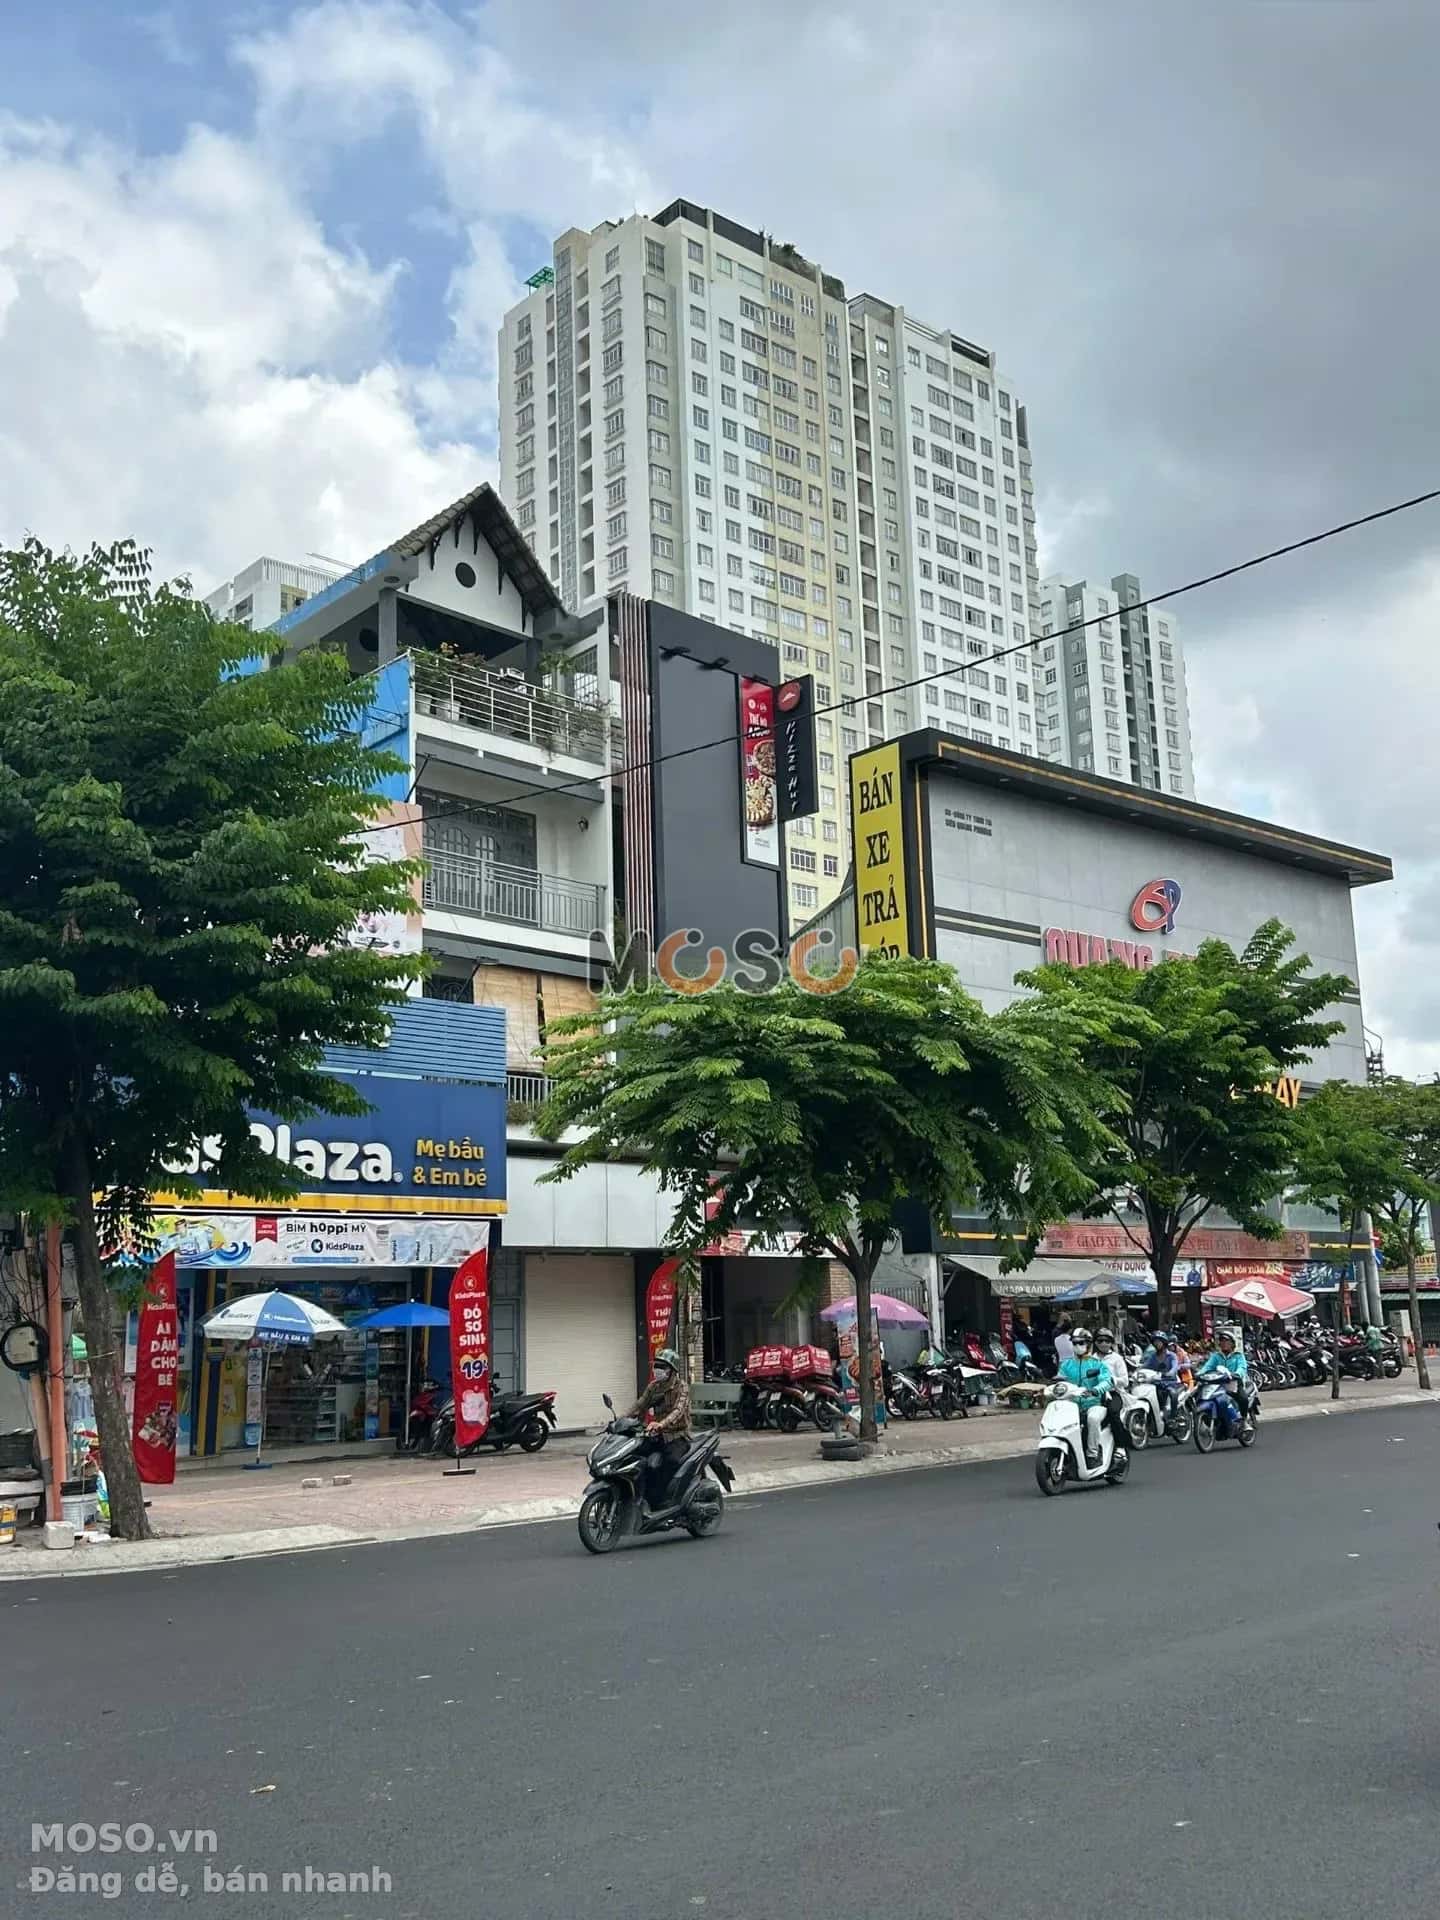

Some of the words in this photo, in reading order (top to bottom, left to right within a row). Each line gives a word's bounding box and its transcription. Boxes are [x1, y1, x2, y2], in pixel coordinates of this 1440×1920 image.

[785, 720, 800, 773] Pizza
[859, 767, 894, 815] BÁN
[865, 830, 891, 869] XE
[863, 874, 900, 927] TRẢ
[1046, 926, 1154, 972] QUANG
[415, 1138, 446, 1162] Mẹ
[448, 1136, 485, 1160] bầu
[413, 1166, 427, 1184] &
[429, 1167, 460, 1185] Em
[463, 1167, 488, 1187] bé
[325, 1242, 365, 1252] KidsPlaza
[151, 1356, 177, 1370] CHO
